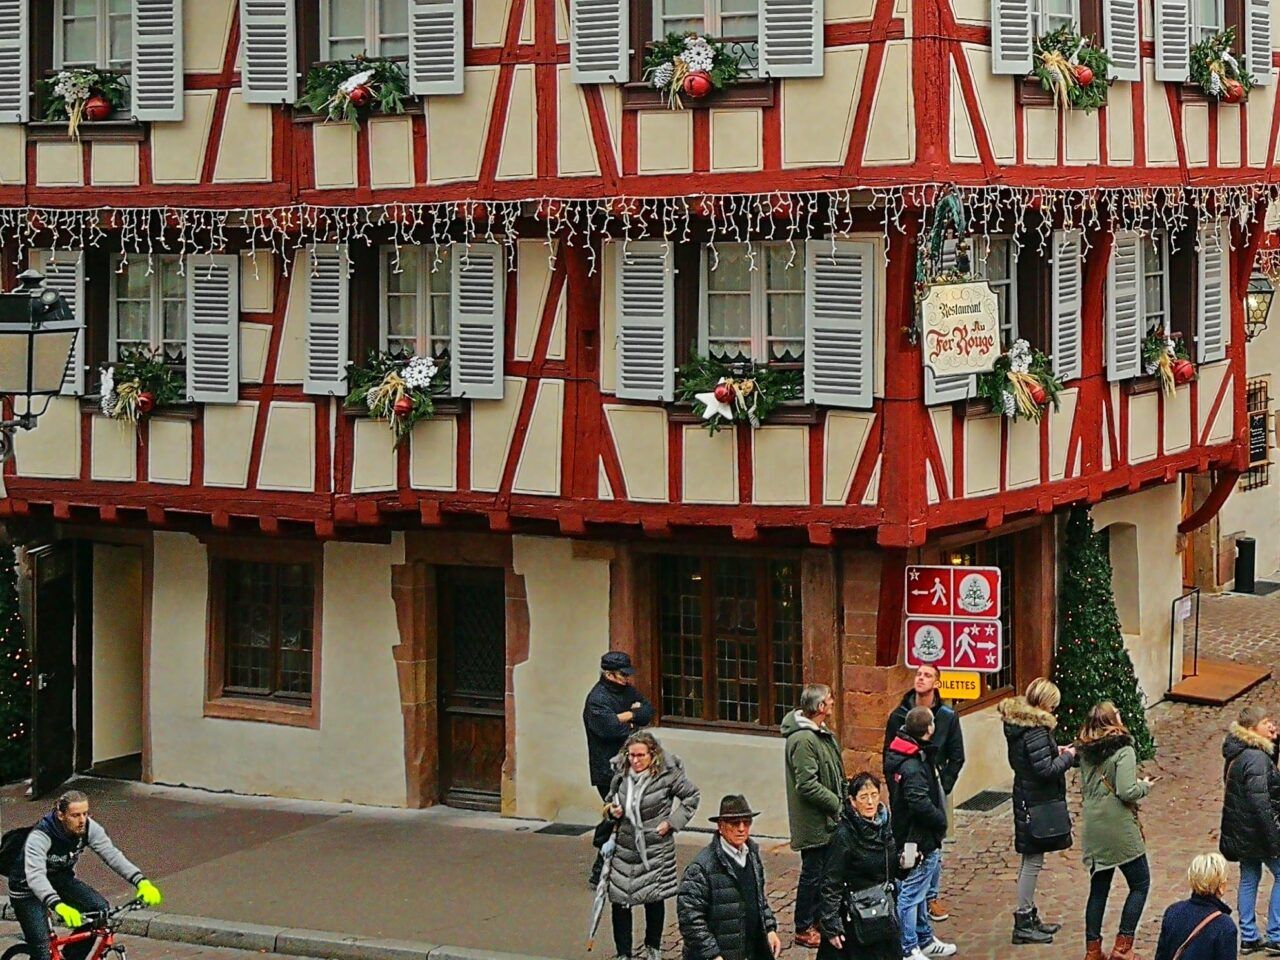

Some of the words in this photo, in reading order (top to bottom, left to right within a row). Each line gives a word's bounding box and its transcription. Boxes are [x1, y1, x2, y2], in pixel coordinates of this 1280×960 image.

[939, 301, 982, 318] Restaurant
[971, 321, 986, 332] Au
[926, 329, 954, 363] Fer
[952, 324, 995, 357] Rouge
[937, 680, 976, 690] OILETTES
